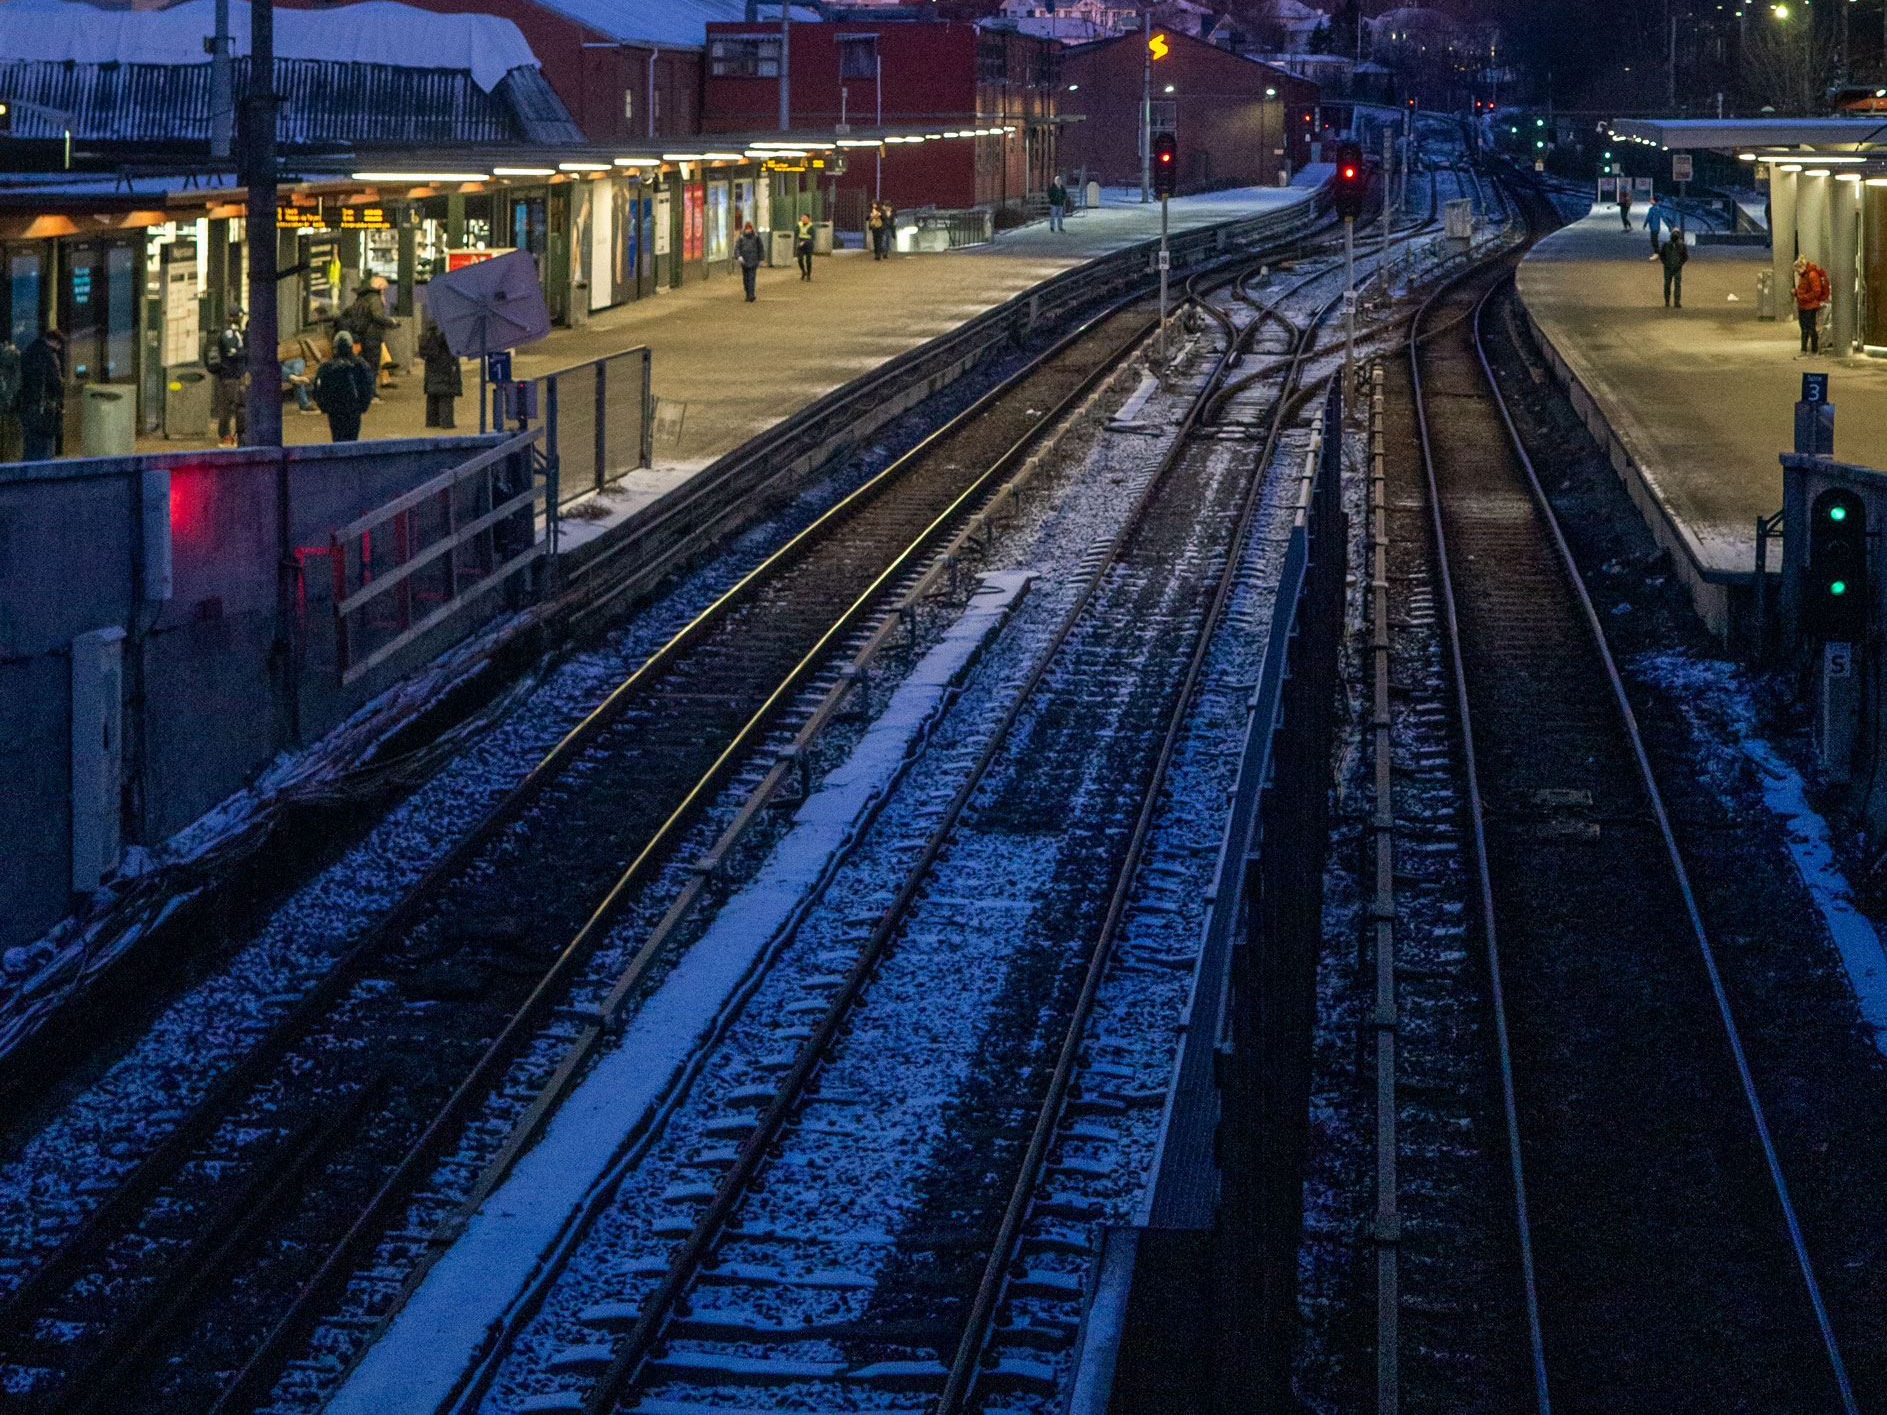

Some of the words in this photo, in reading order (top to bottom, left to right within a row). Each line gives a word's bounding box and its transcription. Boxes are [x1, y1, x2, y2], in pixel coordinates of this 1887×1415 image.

[1160, 255, 1168, 265] S
[1345, 297, 1354, 307] S
[1808, 383, 1821, 402] 3
[1831, 654, 1846, 674] S
